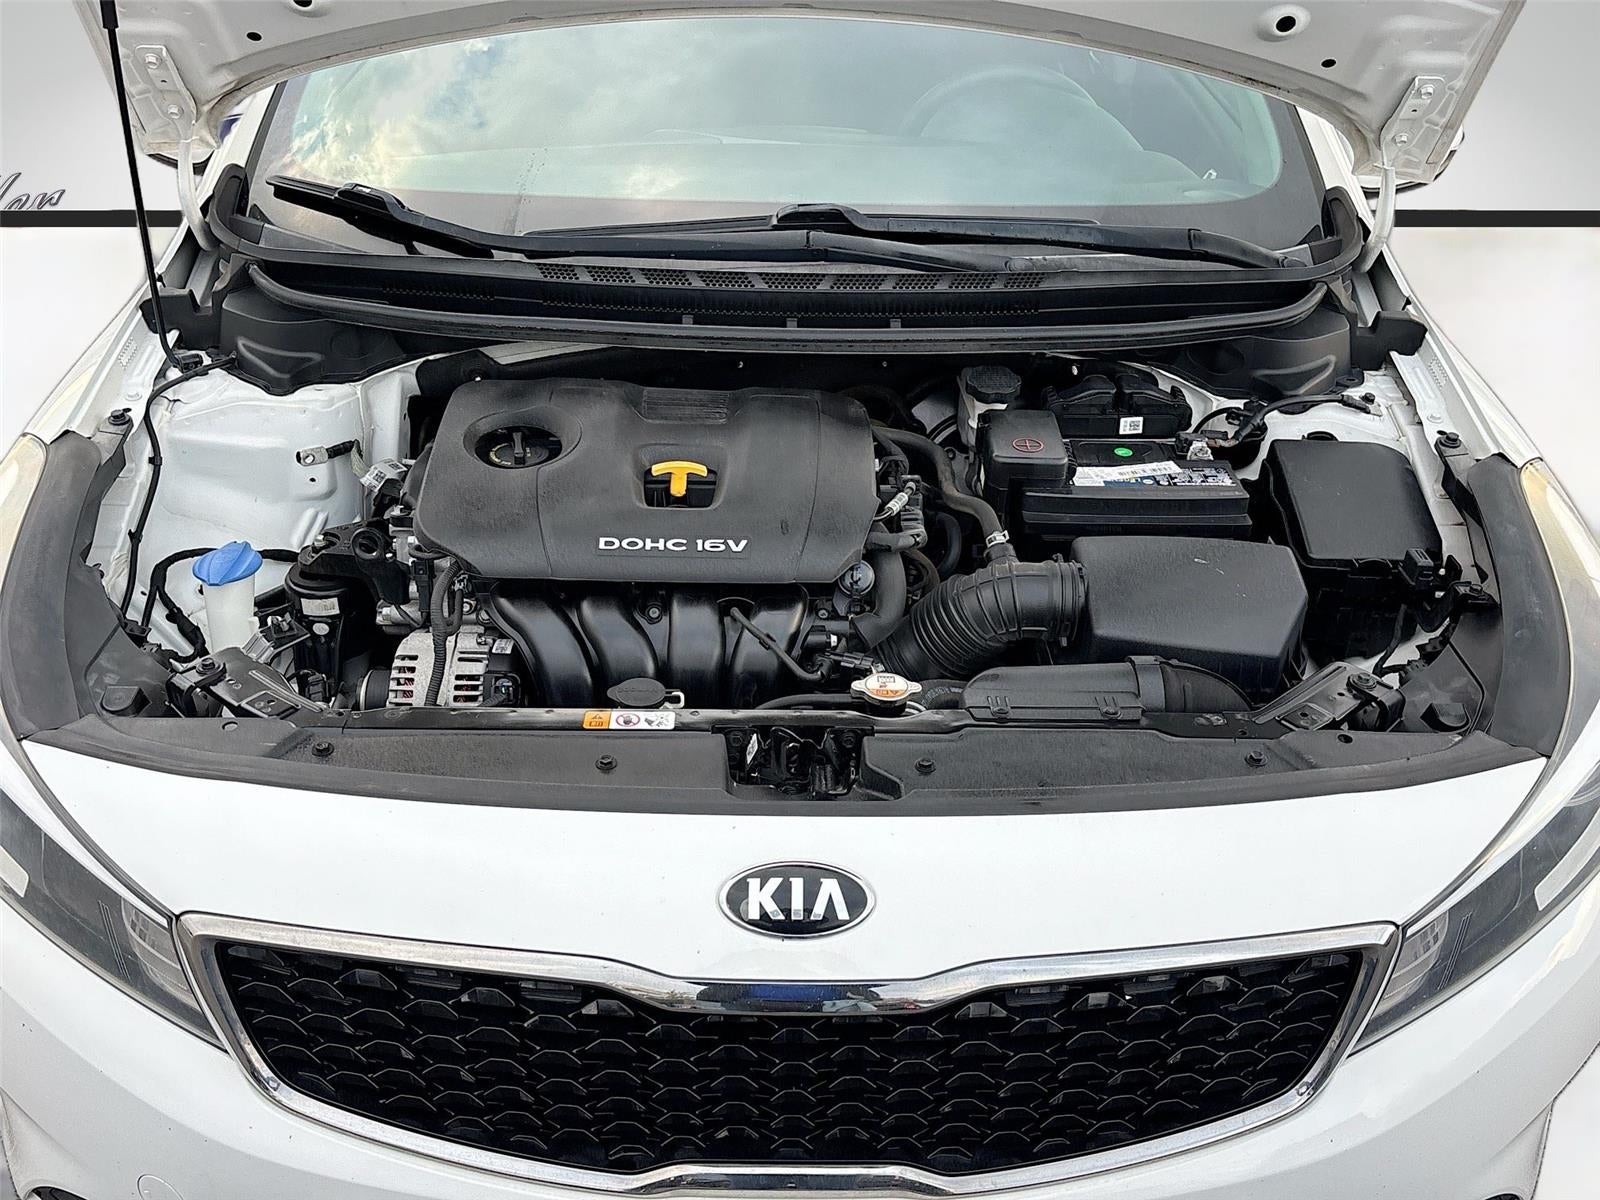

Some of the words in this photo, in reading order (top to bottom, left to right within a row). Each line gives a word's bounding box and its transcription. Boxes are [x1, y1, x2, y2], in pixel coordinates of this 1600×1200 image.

[598, 537, 687, 551] DOHC
[696, 538, 748, 552] 16V
[746, 877, 850, 921] KIA
